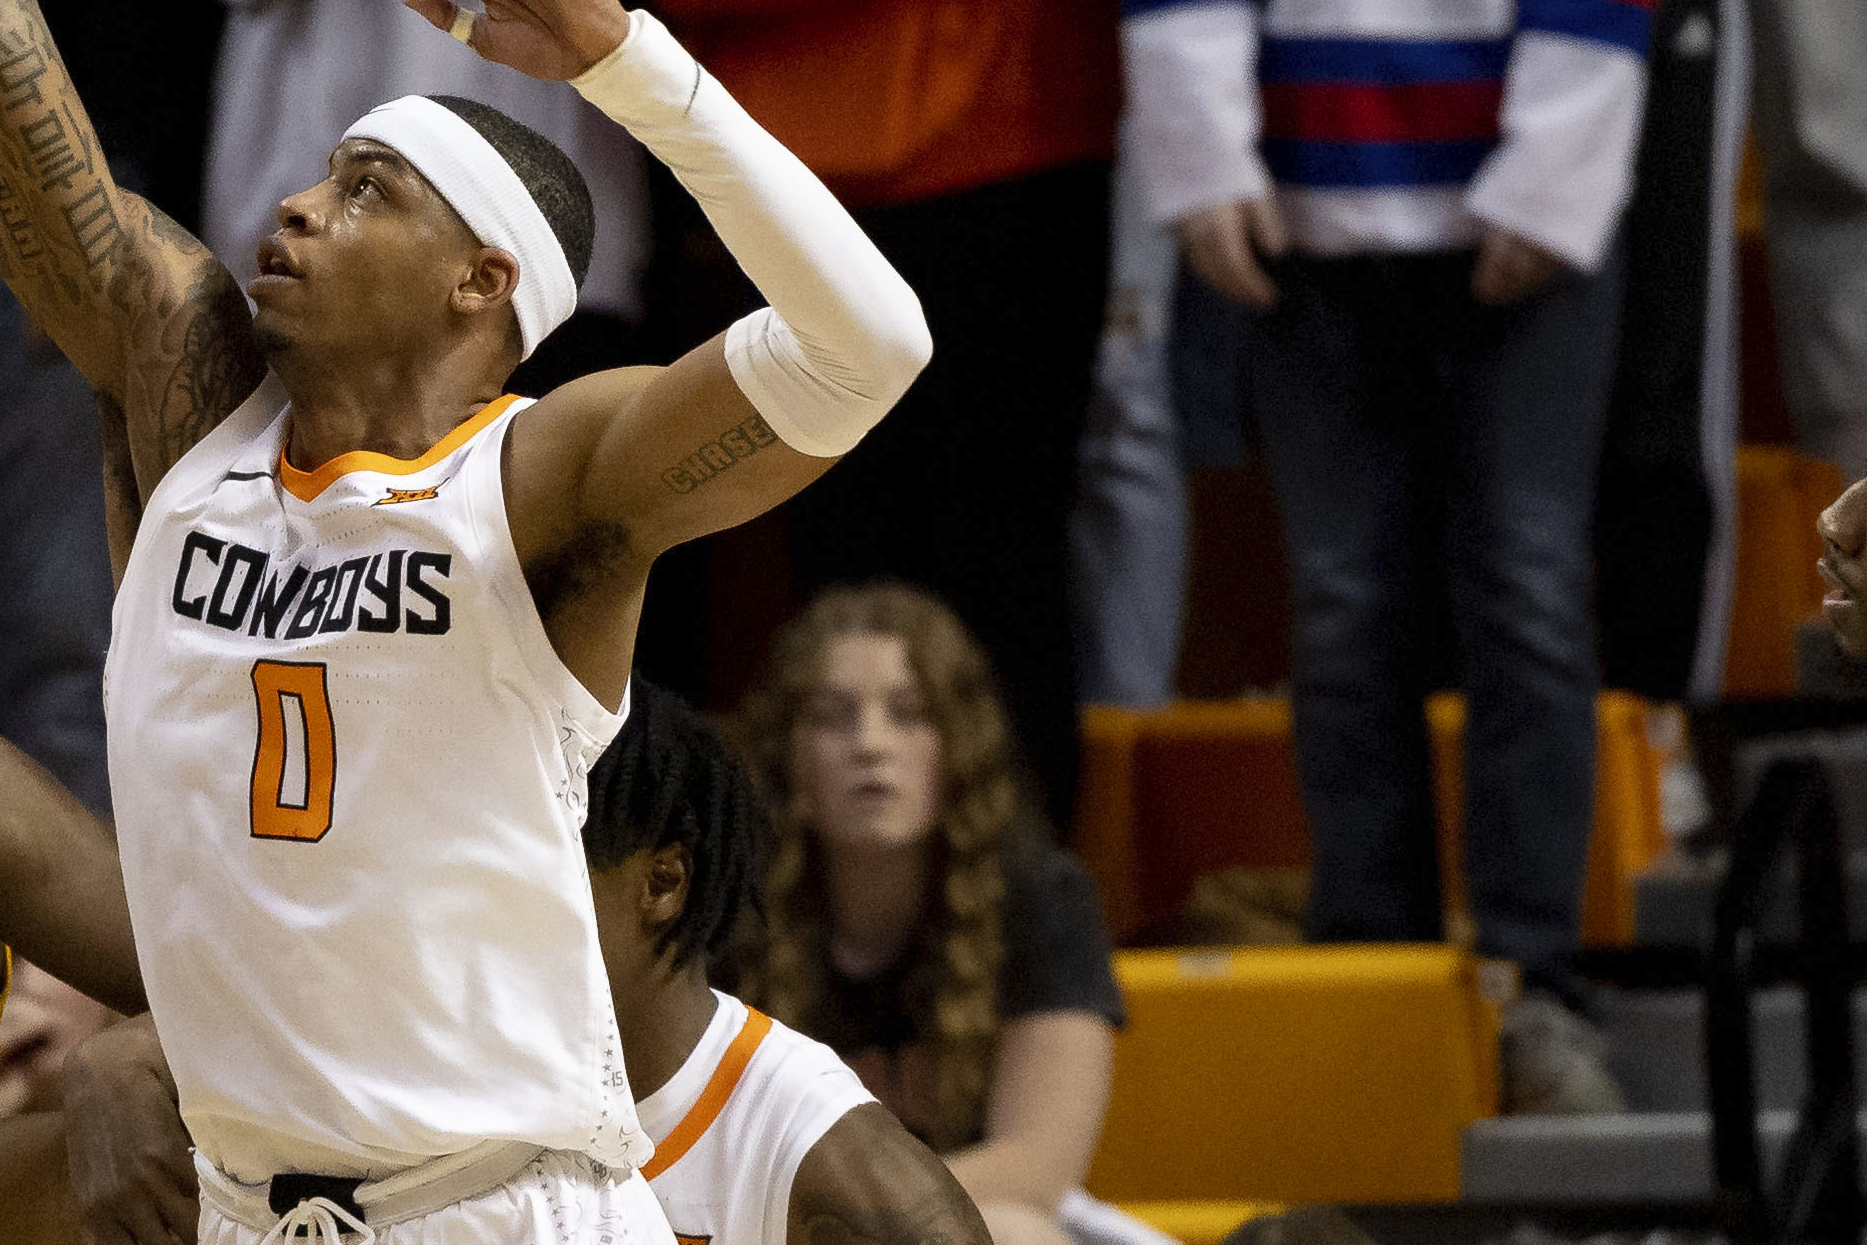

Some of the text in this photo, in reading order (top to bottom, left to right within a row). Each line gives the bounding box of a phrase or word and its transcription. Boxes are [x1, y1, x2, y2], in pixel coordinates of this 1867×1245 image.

[660, 412, 780, 495] CHASE
[171, 529, 453, 641] COWBOYS
[248, 657, 337, 844] 0
